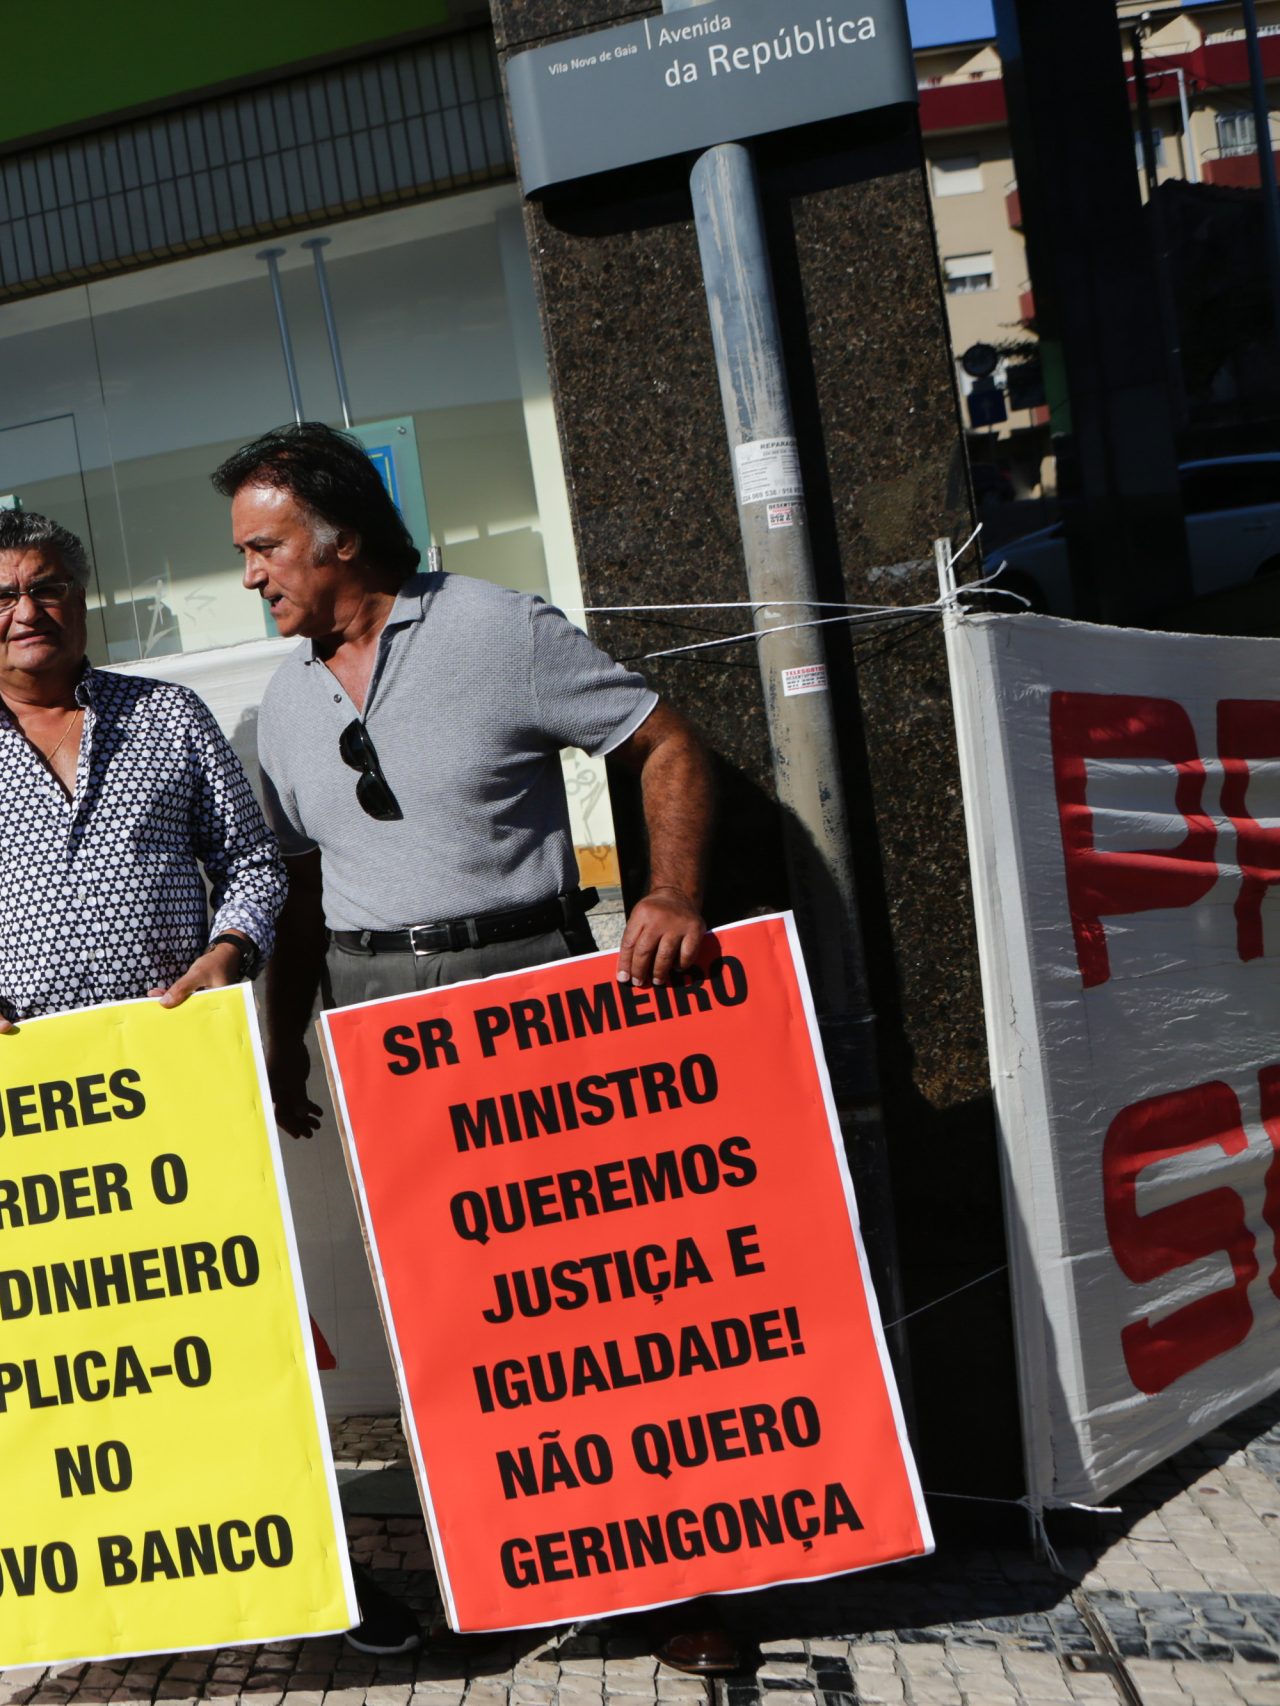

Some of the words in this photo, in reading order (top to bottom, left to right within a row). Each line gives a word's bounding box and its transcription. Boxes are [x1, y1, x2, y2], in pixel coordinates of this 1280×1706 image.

[548, 61, 569, 76] Vila
[570, 55, 597, 70] Nova
[599, 49, 612, 62] de
[614, 44, 638, 59] Gaia
[658, 14, 732, 47] Avenida
[665, 60, 699, 88] da
[707, 15, 876, 76] República
[382, 1019, 460, 1077] SR
[473, 954, 749, 1058] PRIMEIRO
[448, 1052, 719, 1153] MINISTRO
[150, 1152, 190, 1206] O
[449, 1135, 758, 1246] QUEREMOS
[482, 1236, 714, 1324] JUSTIÇA
[726, 1224, 766, 1278] E
[472, 1306, 806, 1414] IGUALDADE!
[53, 1439, 134, 1499] NO
[496, 1429, 614, 1500] NÃO
[631, 1395, 821, 1480] QUERO
[96, 1513, 295, 1588] BANCO
[500, 1482, 864, 1590] GERINGONÇA
